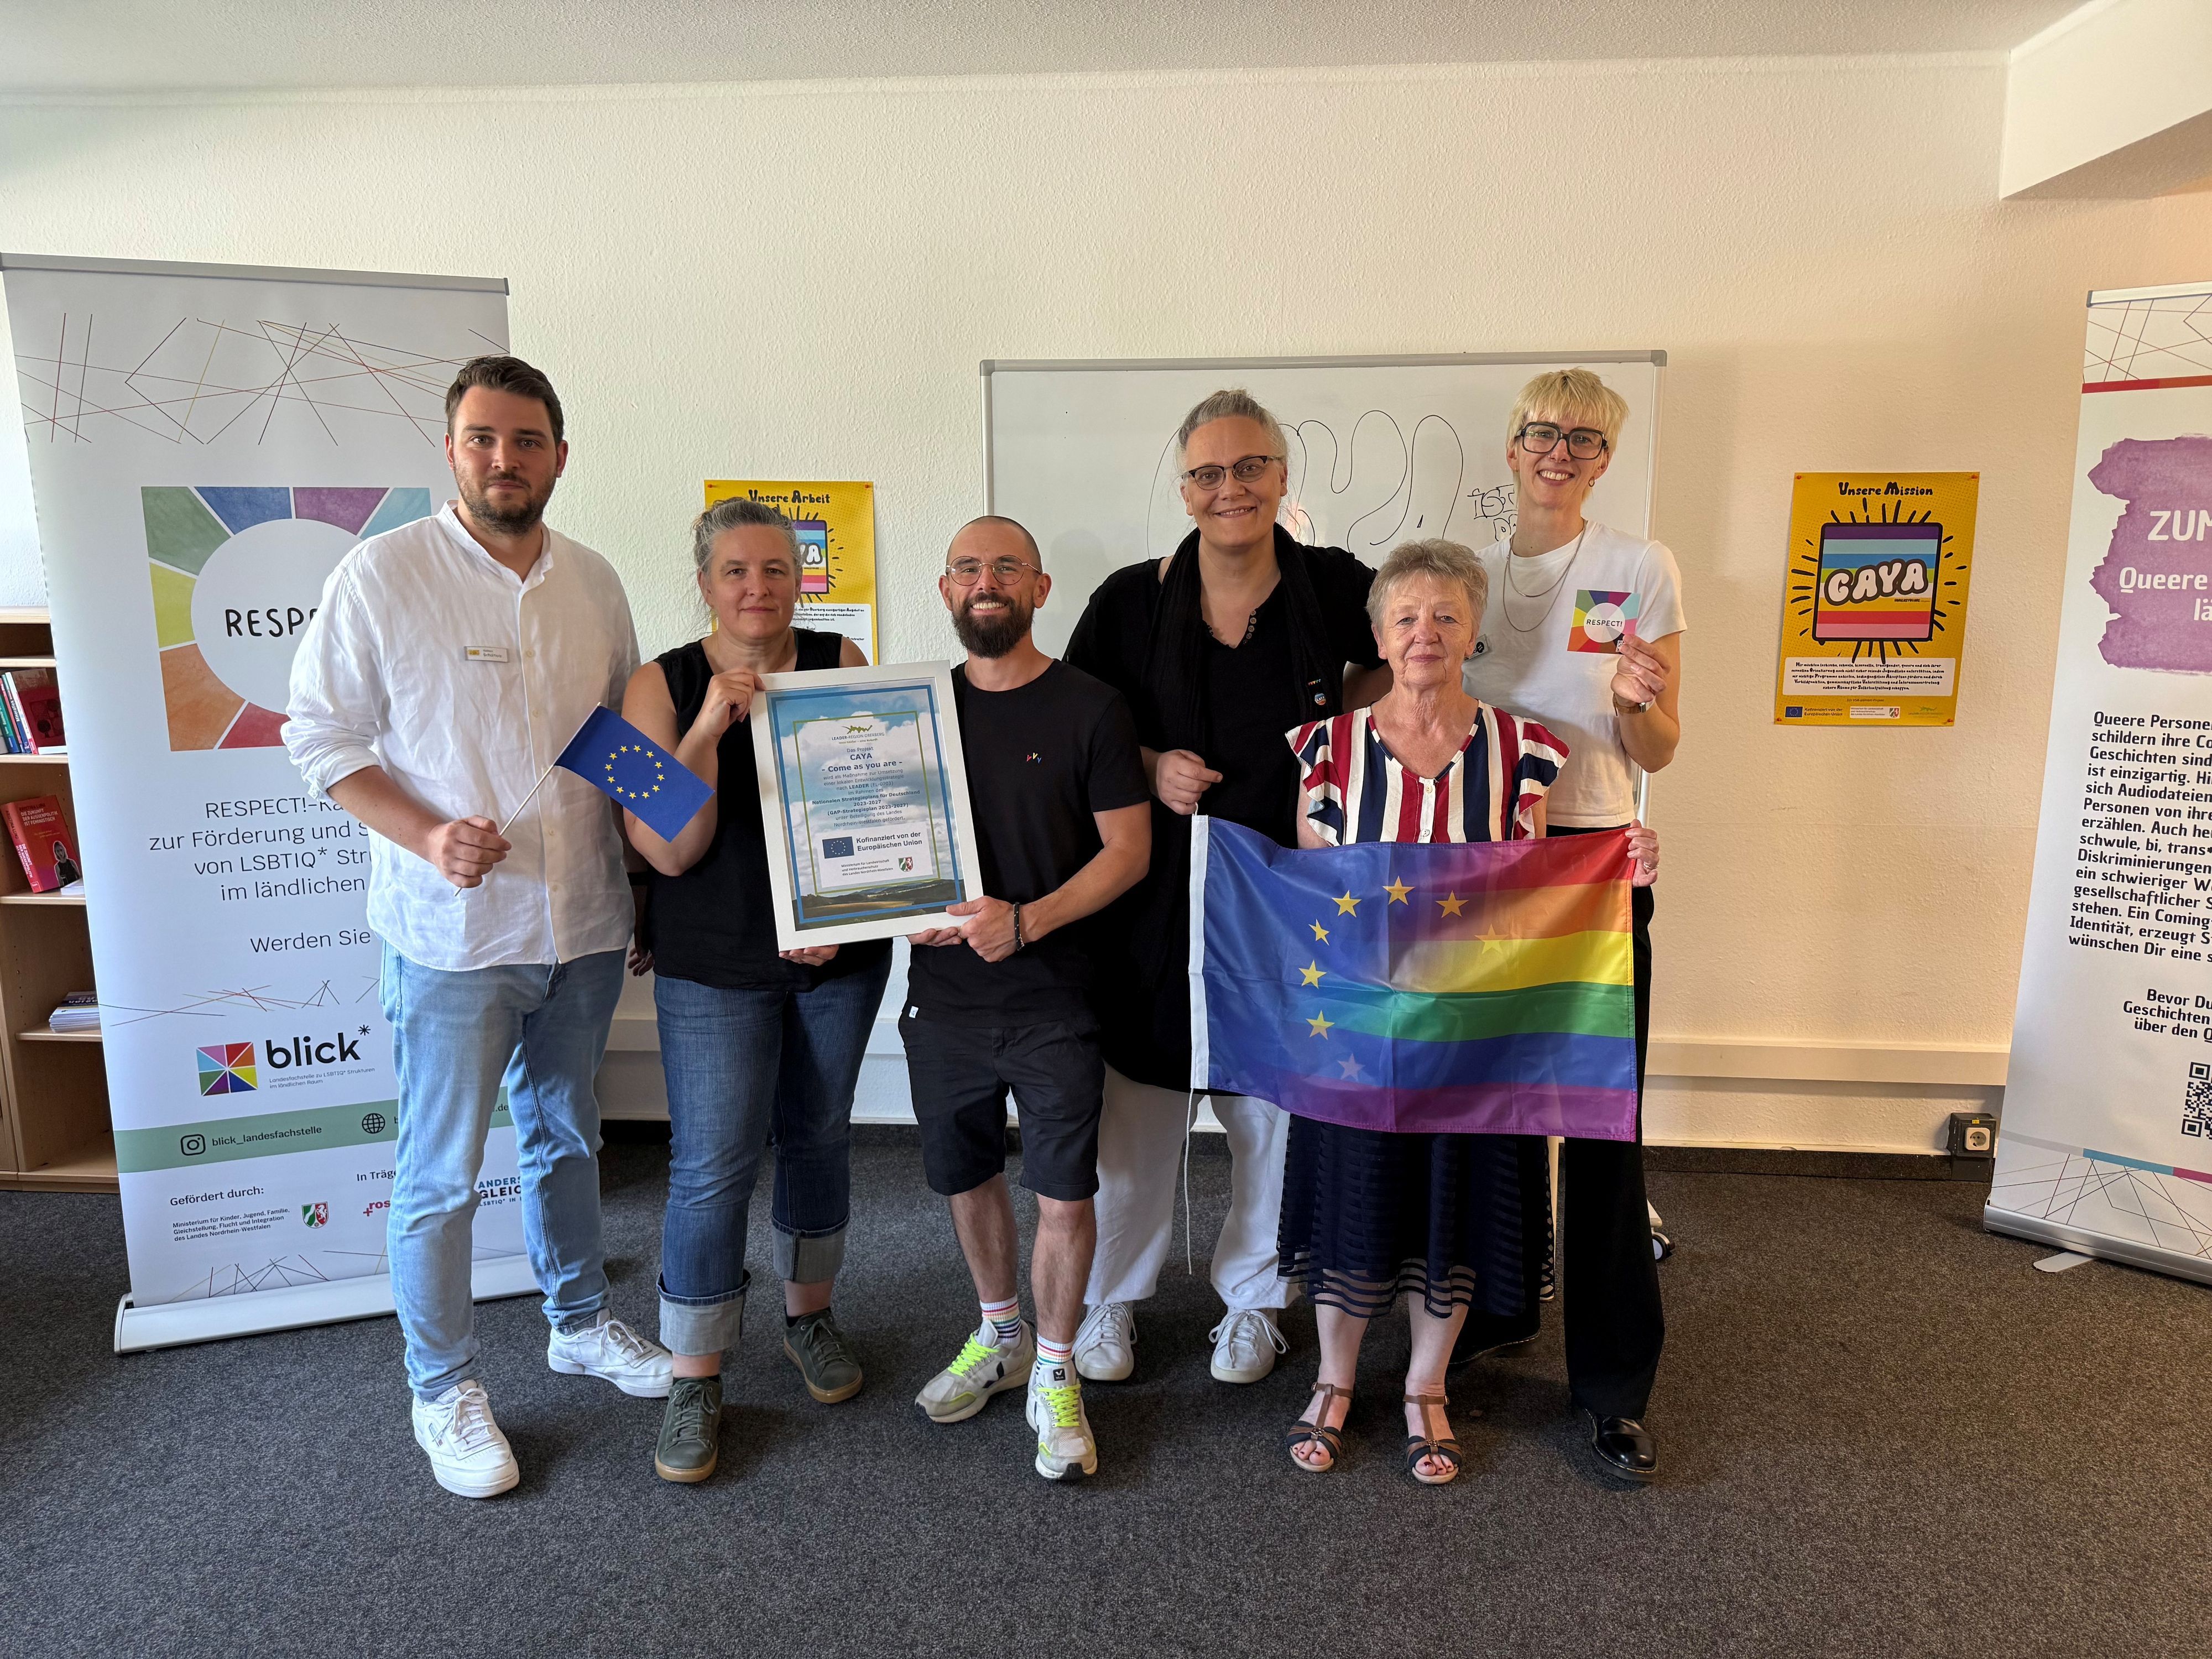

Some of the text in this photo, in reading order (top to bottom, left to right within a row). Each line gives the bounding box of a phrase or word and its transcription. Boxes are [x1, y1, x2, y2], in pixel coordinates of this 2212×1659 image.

[748, 489, 830, 504] Unsere Arbeit
[1838, 482, 1933, 496] Unsere Mission
[2147, 510, 2212, 541] ZUM
[2120, 567, 2208, 593] Queere
[2094, 711, 2212, 730] Queere Persone
[2091, 729, 2156, 745] schildern
[2162, 733, 2190, 747] ihre
[2090, 746, 2212, 766] Geschichten sind
[2088, 763, 2106, 777] ist
[2110, 765, 2190, 786] einzigartig.
[842, 794, 879, 802] Strategieplans
[2086, 781, 2212, 802] sich Audiodateien
[2084, 797, 2149, 816] Personen
[2156, 807, 2181, 818] von
[149, 835, 185, 851] zur
[192, 827, 305, 848] Förderung
[312, 821, 351, 839] und
[2081, 817, 2145, 833] erzählen.
[2151, 821, 2187, 836] Auch
[857, 834, 895, 843] Kofinanziert
[857, 841, 901, 851] Europäischen
[2080, 833, 2140, 851] schwule,
[2146, 838, 2162, 853] bi,
[194, 860, 232, 875] von
[337, 849, 372, 865] Str
[2078, 848, 2211, 875] Diskriminierungen
[2076, 866, 2096, 880] ein
[2101, 870, 2188, 890] schwieriger
[221, 876, 365, 901] im ländlichen
[2074, 885, 2200, 908] gesellschaftlicher
[2072, 901, 2212, 930] stehen. Ein Coming
[2070, 916, 2133, 937] Identität,
[2139, 927, 2196, 945] erzeugt
[250, 929, 371, 953] Werden Sie
[2069, 934, 2138, 953] wünschen
[2144, 942, 2166, 956] Dir
[2171, 947, 2201, 961] eine
[2147, 989, 2190, 1006] Bevor
[2124, 1001, 2210, 1025] Geschichten
[2135, 1017, 2167, 1033] über
[2172, 1023, 2198, 1038] den
[269, 1073, 315, 1083] Landesfachstelle
[212, 1126, 322, 1146] blick_landesfachstelle
[170, 1186, 264, 1206] Gefördert durch:
[173, 1219, 209, 1228] Ministerium
[243, 1211, 266, 1219] Jugend,
[174, 1224, 218, 1235] Gleichstellung,
[252, 1215, 284, 1224] Integration
[210, 1224, 271, 1237] Nordrhein-Westfalen
